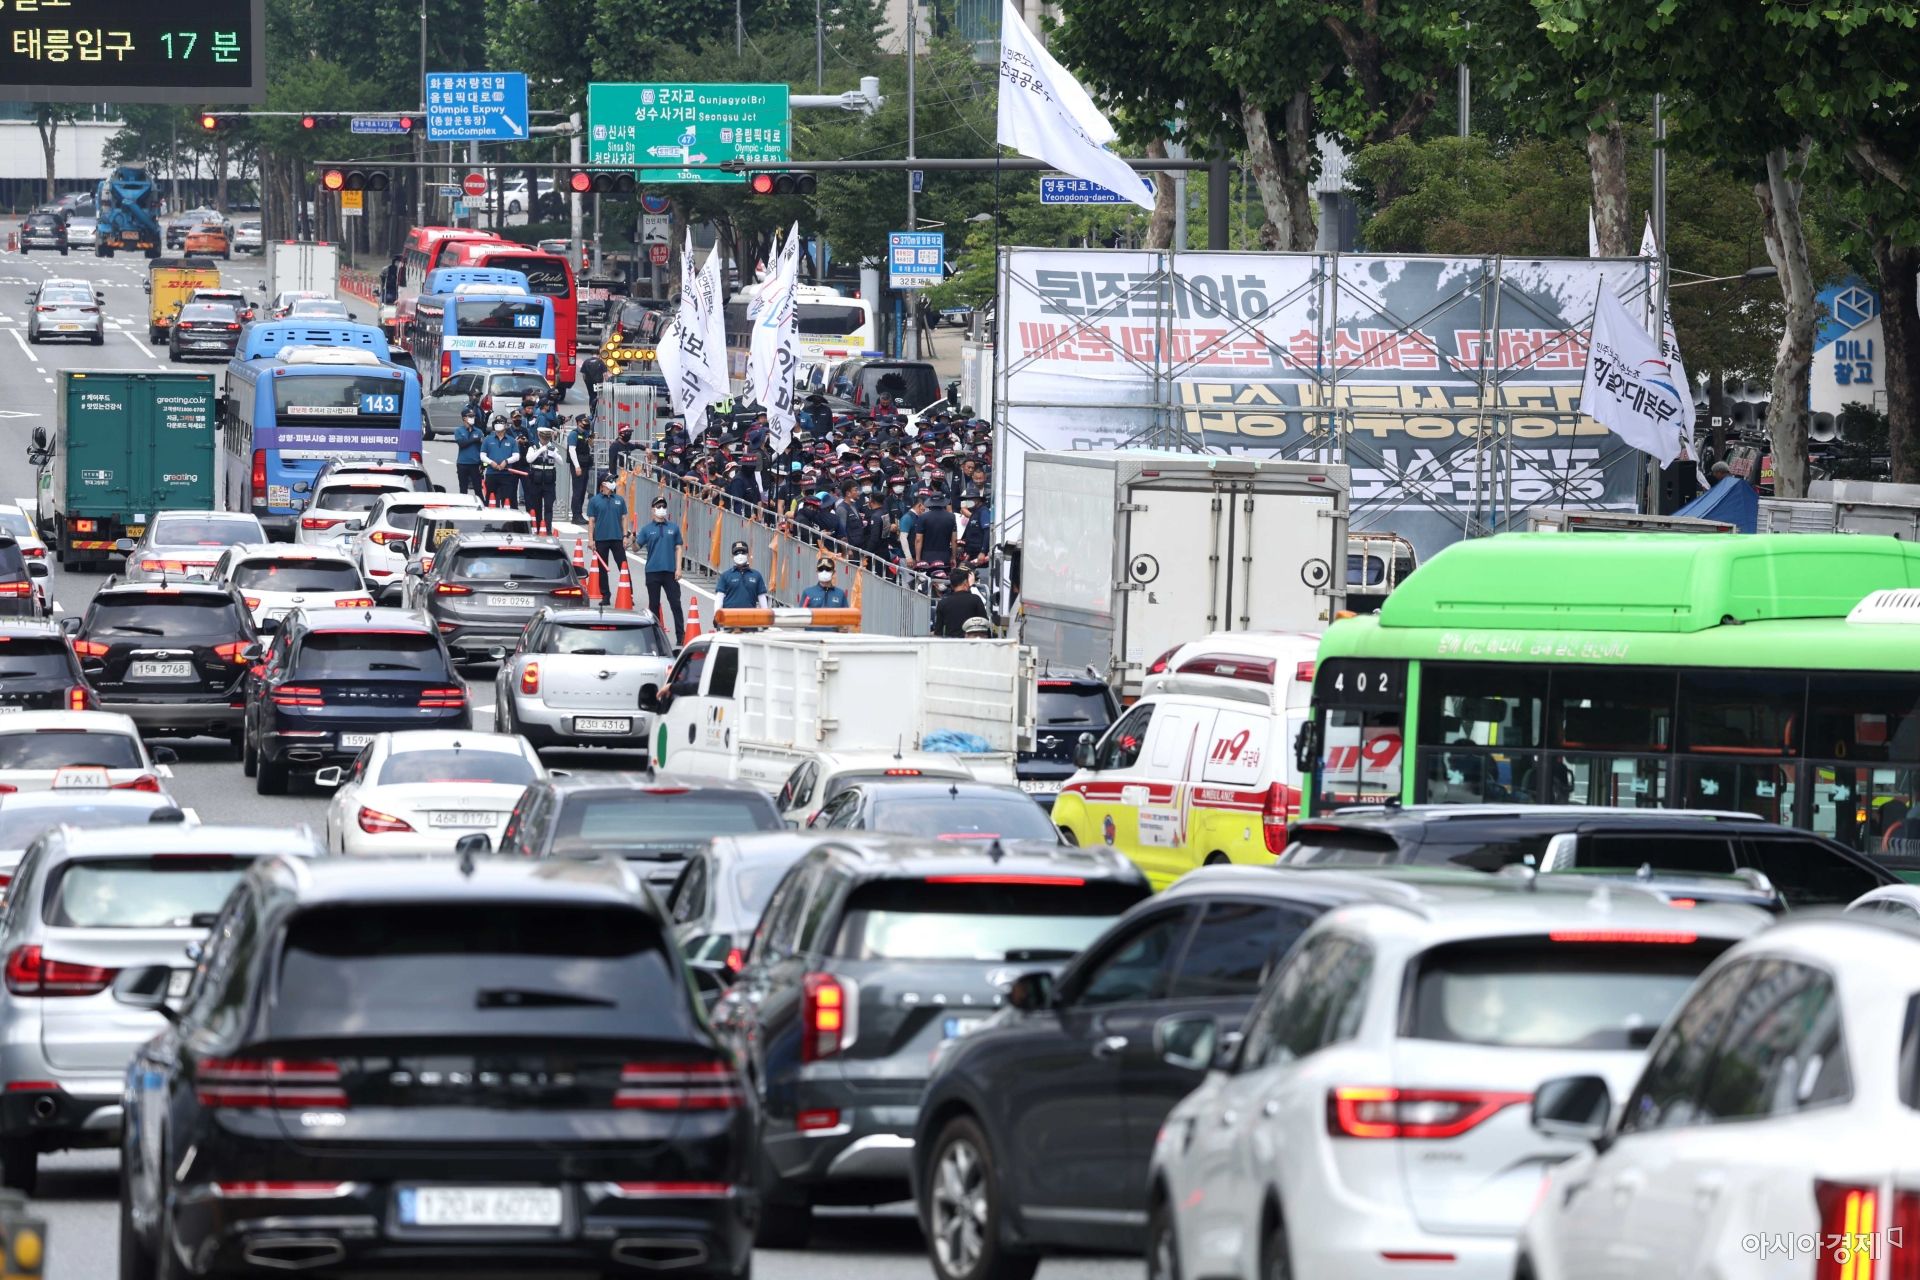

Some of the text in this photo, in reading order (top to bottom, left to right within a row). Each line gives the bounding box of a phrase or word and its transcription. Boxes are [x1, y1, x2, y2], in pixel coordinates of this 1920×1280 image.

[13, 28, 241, 62] 태릉입구 17 분
[430, 77, 505, 90] 화물차량진입
[430, 92, 491, 104] 올림픽대로
[658, 89, 695, 104] 군자교
[698, 95, 766, 105] Gunjagyo(Br)
[472, 105, 505, 115] Expwy
[635, 107, 696, 122] 성수사거리
[430, 115, 486, 126] (종합운동장)
[698, 112, 739, 122] Seongsu
[457, 127, 497, 136] Complex
[608, 125, 636, 140] 신사역
[734, 128, 781, 143] 올림픽대로
[1044, 193, 1115, 205] Yeongdong-daero
[527, 271, 563, 284] Club
[517, 316, 536, 327] 146
[1835, 339, 1873, 361] 미니
[1834, 362, 1874, 385] 창고
[156, 396, 206, 405] greating.co.kr
[366, 396, 394, 412] 143
[360, 435, 399, 444] 바비톡하다
[163, 473, 198, 482] greating
[161, 665, 186, 675] 2768
[602, 720, 626, 730] 4316
[1210, 729, 1250, 762] 119
[1323, 733, 1402, 773] 119
[63, 774, 101, 785] TAXI
[1202, 789, 1235, 802] AMBULANCE
